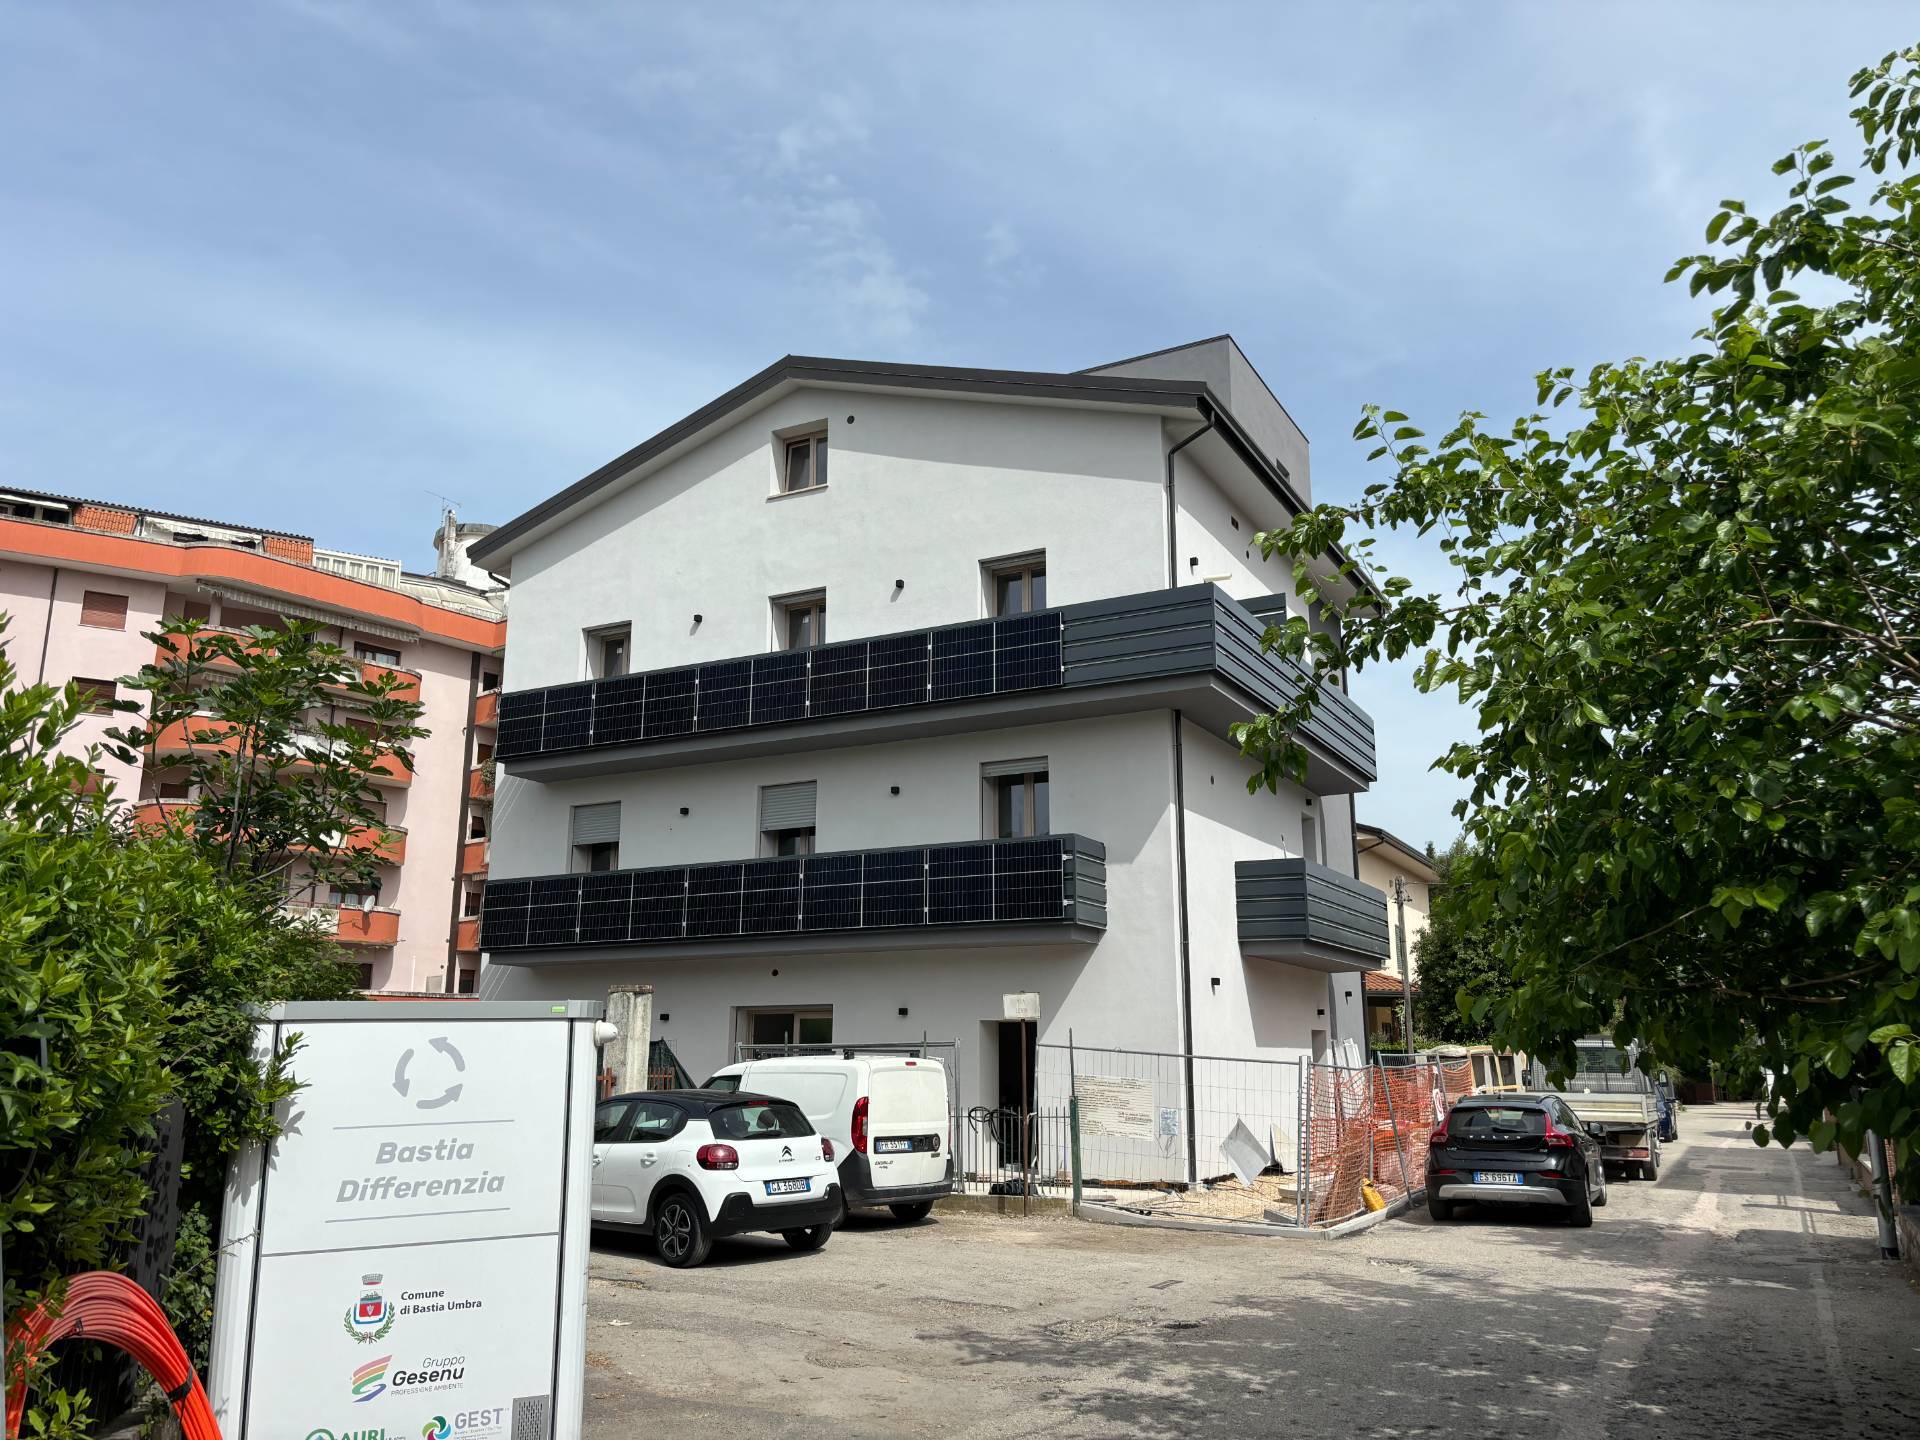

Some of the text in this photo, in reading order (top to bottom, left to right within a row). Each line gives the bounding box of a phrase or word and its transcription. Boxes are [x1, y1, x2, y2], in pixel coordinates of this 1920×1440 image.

[375, 1138, 474, 1164] Bastia
[336, 1170, 505, 1202] Differenzia
[400, 1289, 445, 1301] Comune
[400, 1299, 482, 1315] di Bastia Umbra
[422, 1355, 466, 1369] Gruppo
[392, 1367, 465, 1387] Gesenu
[454, 1408, 504, 1430] GEST
